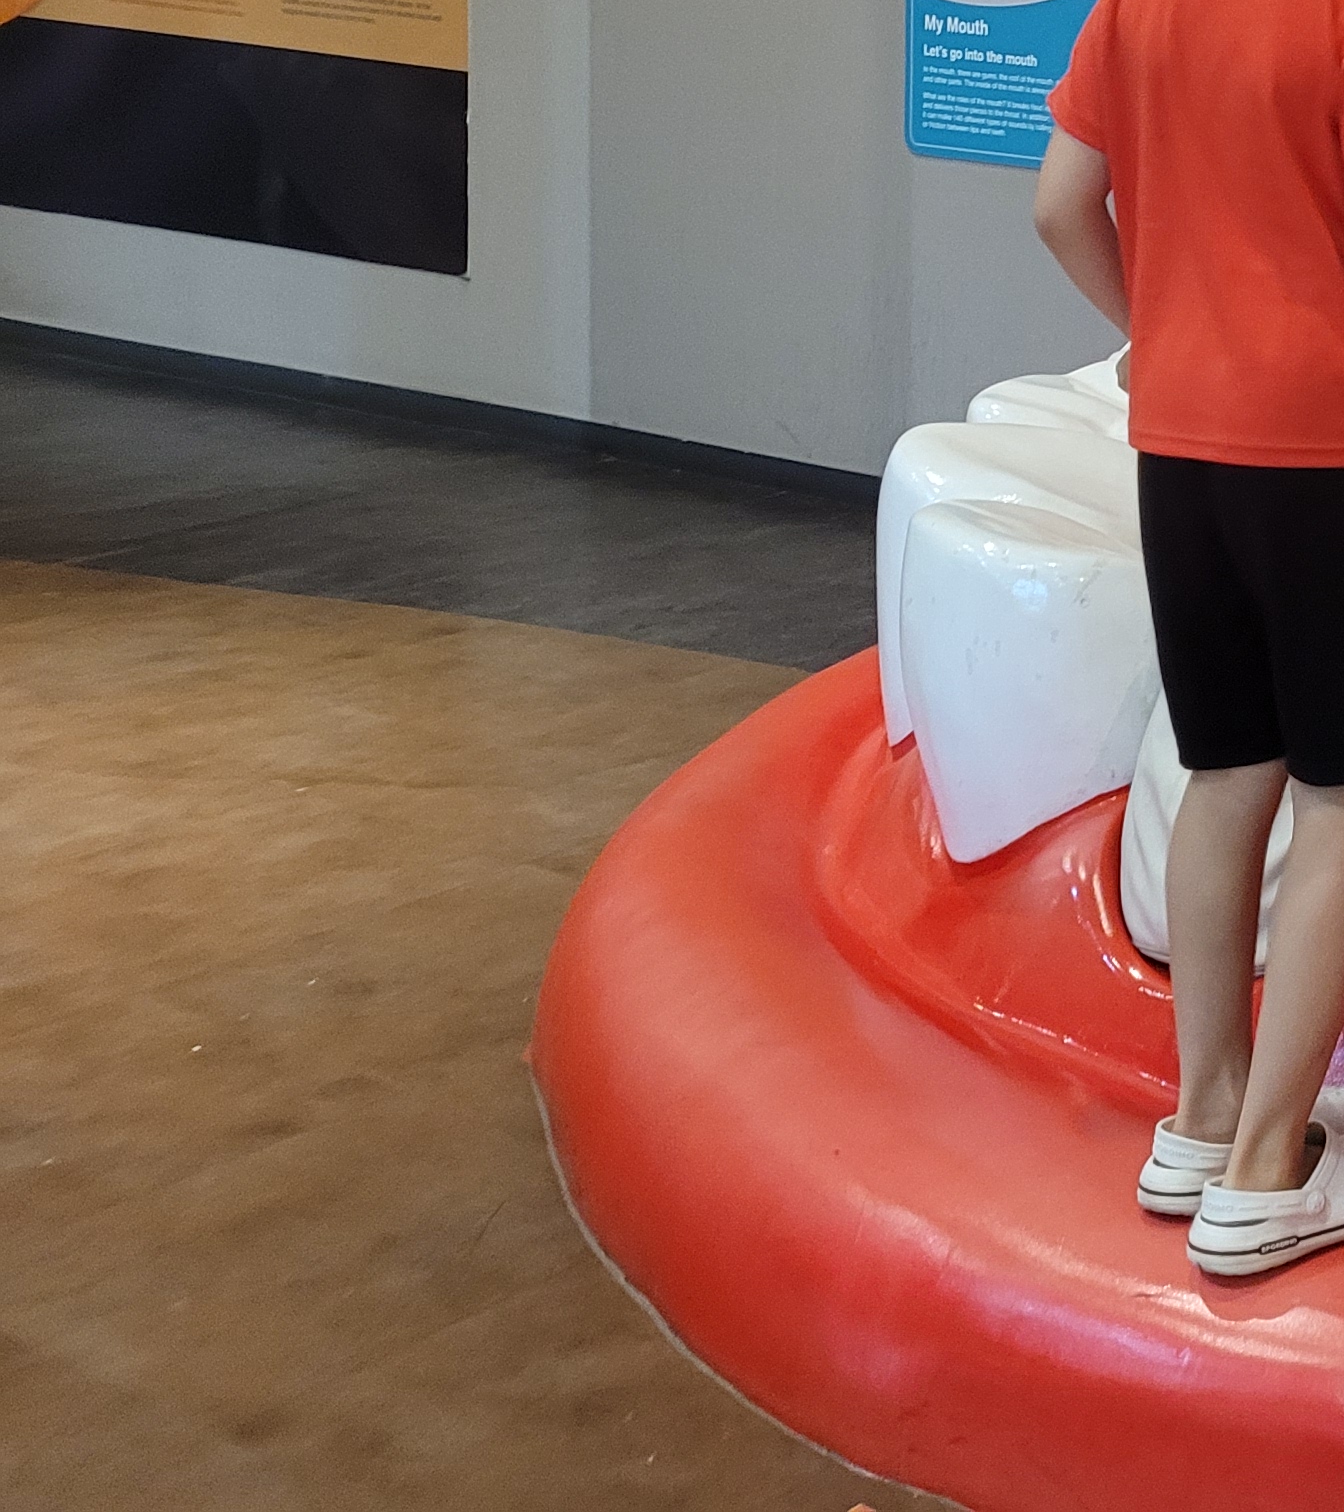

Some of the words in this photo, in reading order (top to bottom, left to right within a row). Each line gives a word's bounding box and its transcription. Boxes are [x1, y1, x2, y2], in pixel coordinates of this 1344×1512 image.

[924, 14, 943, 35] My
[947, 16, 989, 36] Mouth
[923, 44, 948, 57] Let's
[950, 49, 962, 61] go
[965, 48, 984, 61] into
[986, 51, 1003, 63] the
[1005, 55, 1037, 67] mouth
